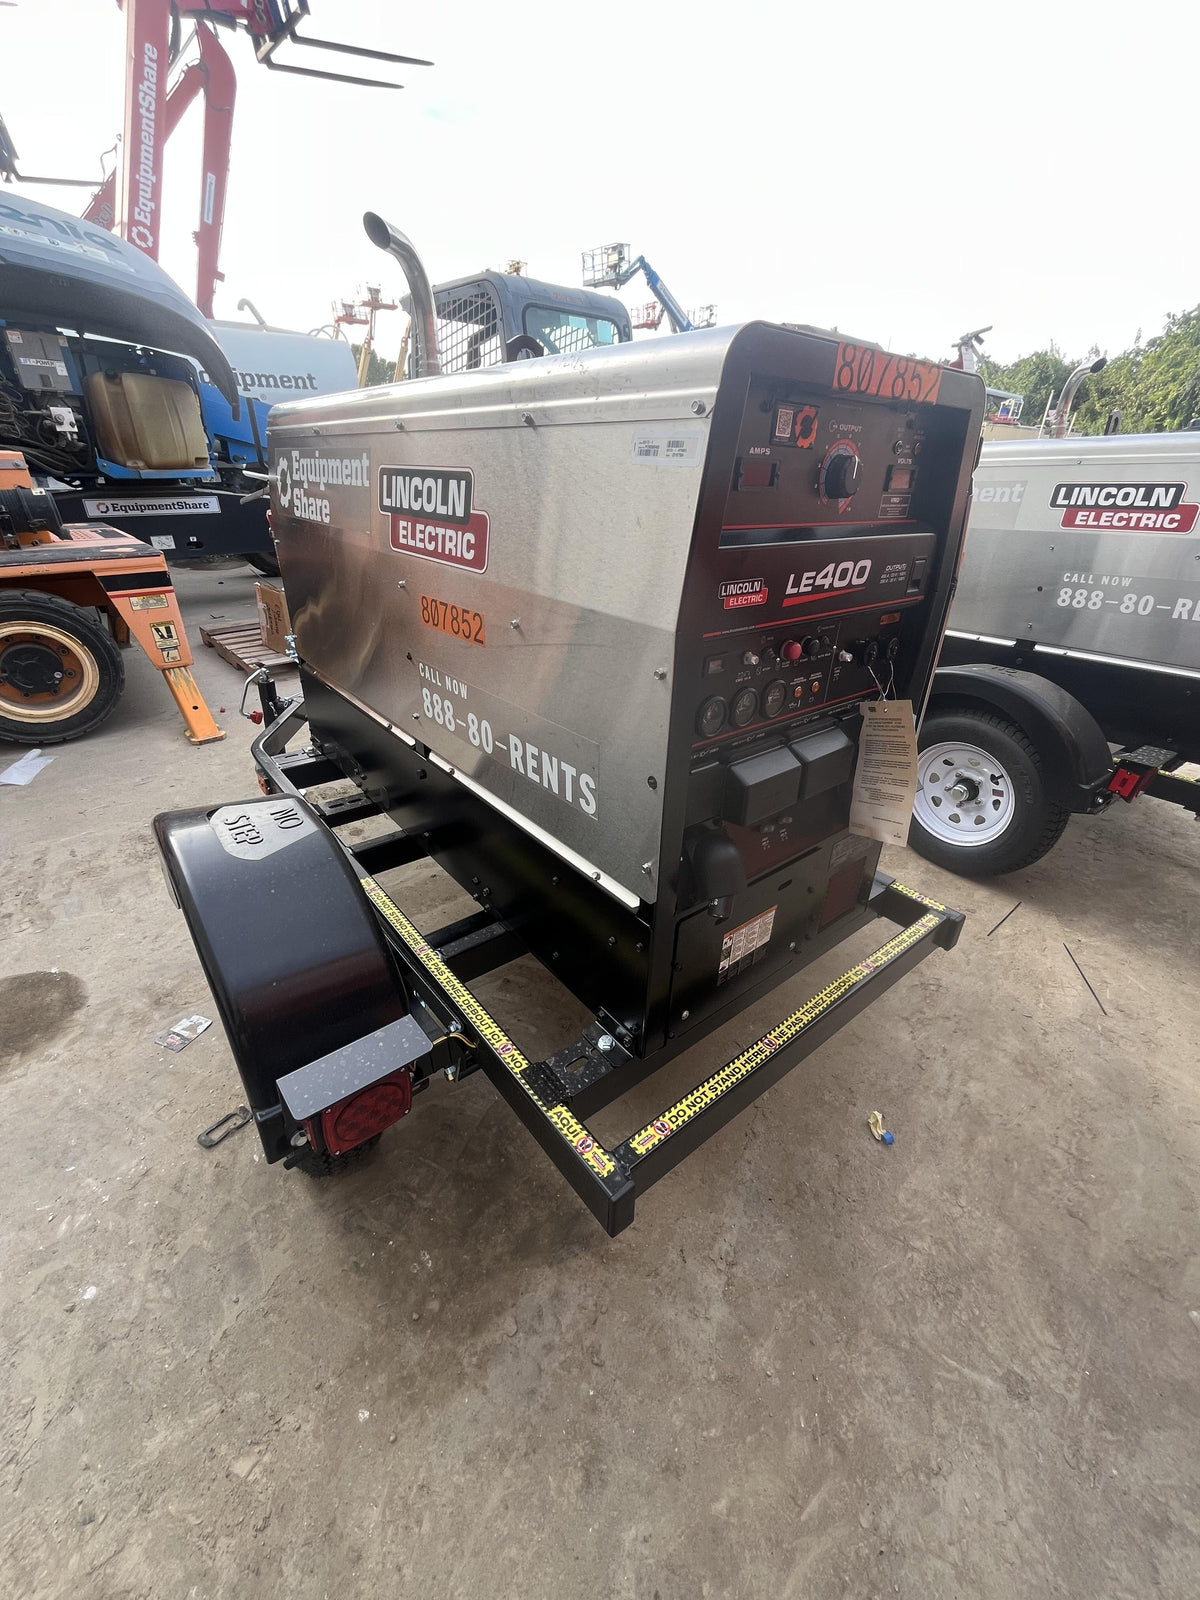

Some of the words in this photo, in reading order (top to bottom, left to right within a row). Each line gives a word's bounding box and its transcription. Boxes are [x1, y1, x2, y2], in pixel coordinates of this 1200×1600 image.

[134, 43, 158, 226] EquipmentShare
[837, 343, 940, 402] 807852
[839, 423, 862, 432] OUTPUT
[749, 447, 771, 455] AMPS
[291, 449, 370, 490] Equipment
[110, 501, 209, 513] EquipmentShare
[292, 487, 330, 523] Share
[382, 473, 467, 517] LINCOLN
[1056, 486, 1177, 507] LINCOLN
[1074, 511, 1181, 529] ELECTRIC
[399, 519, 476, 560] ELECTRIC
[721, 580, 761, 596] LINCOLN
[785, 559, 872, 595] LE400
[1063, 572, 1096, 584] CALL
[1101, 575, 1133, 587] NOW
[729, 593, 763, 606] ELECTRIC
[420, 594, 484, 645] 807852
[419, 662, 442, 687] CALL
[445, 675, 468, 699] NOW
[422, 687, 596, 815] 888-80-RENTS
[224, 815, 264, 845] STEP
[270, 807, 304, 830] NO
[373, 892, 384, 901] DO
[381, 899, 393, 911] NOT
[389, 911, 408, 930] STAND
[404, 929, 422, 946] HERE
[423, 952, 436, 963] NE
[431, 962, 446, 977] PAS
[443, 975, 466, 1000] TENEZ
[461, 998, 493, 1030] DEBOUT
[488, 1030, 502, 1043] ICI
[774, 1029, 789, 1042] NE
[785, 1016, 804, 1031] PAS
[800, 998, 826, 1018] TENEZ
[823, 976, 854, 999] DEBOUT
[507, 1053, 523, 1069] NO
[667, 1108, 687, 1124] DO
[685, 1090, 709, 1111] NOT
[707, 1066, 742, 1094] STAND
[740, 1046, 767, 1069] HERE
